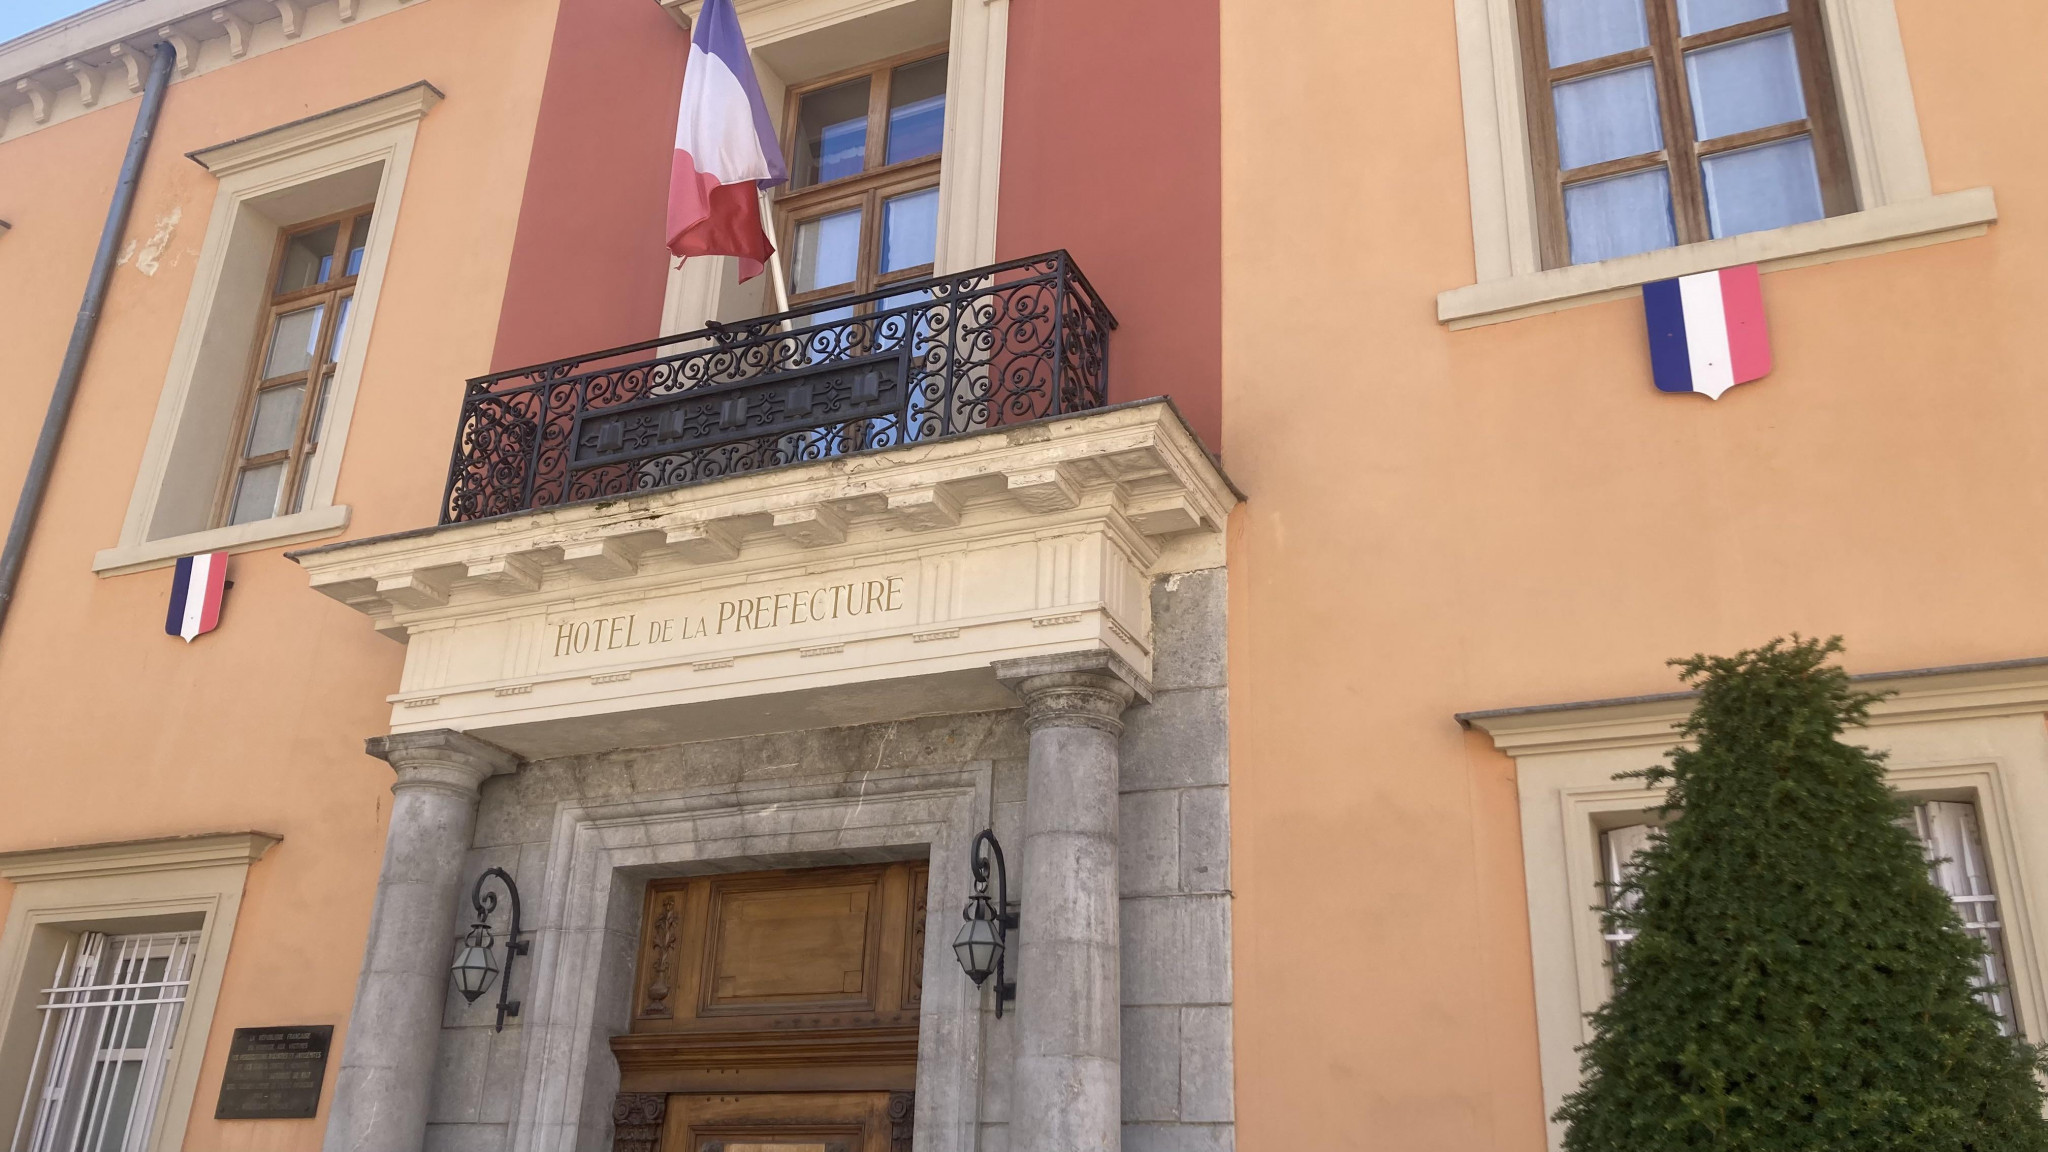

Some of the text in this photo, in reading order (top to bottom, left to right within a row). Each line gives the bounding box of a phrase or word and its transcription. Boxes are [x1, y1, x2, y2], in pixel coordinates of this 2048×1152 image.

[553, 576, 904, 657] HOTEL DE LA PREFECTURE
